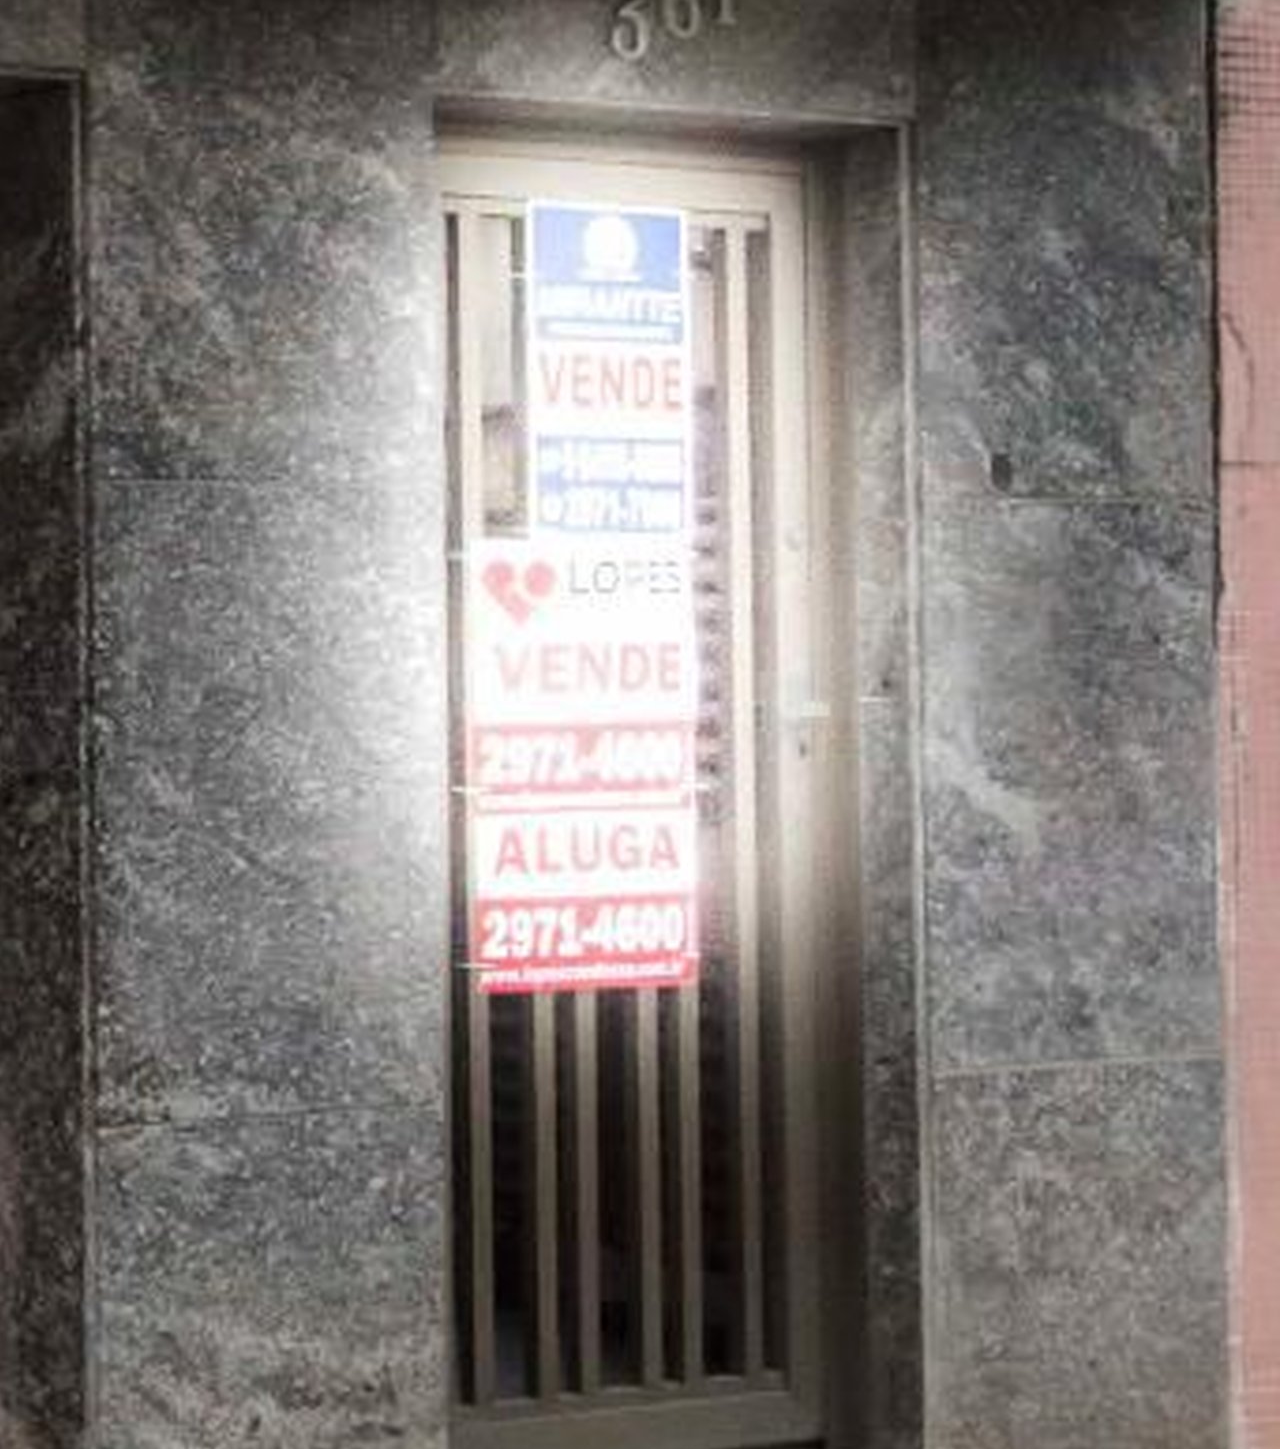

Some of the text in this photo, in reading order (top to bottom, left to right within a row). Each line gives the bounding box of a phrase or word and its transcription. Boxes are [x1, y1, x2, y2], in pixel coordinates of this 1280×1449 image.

[537, 353, 684, 412] VENDE
[568, 560, 682, 595] LOPES
[494, 642, 681, 693] VENDE
[493, 824, 681, 877] ALUGA
